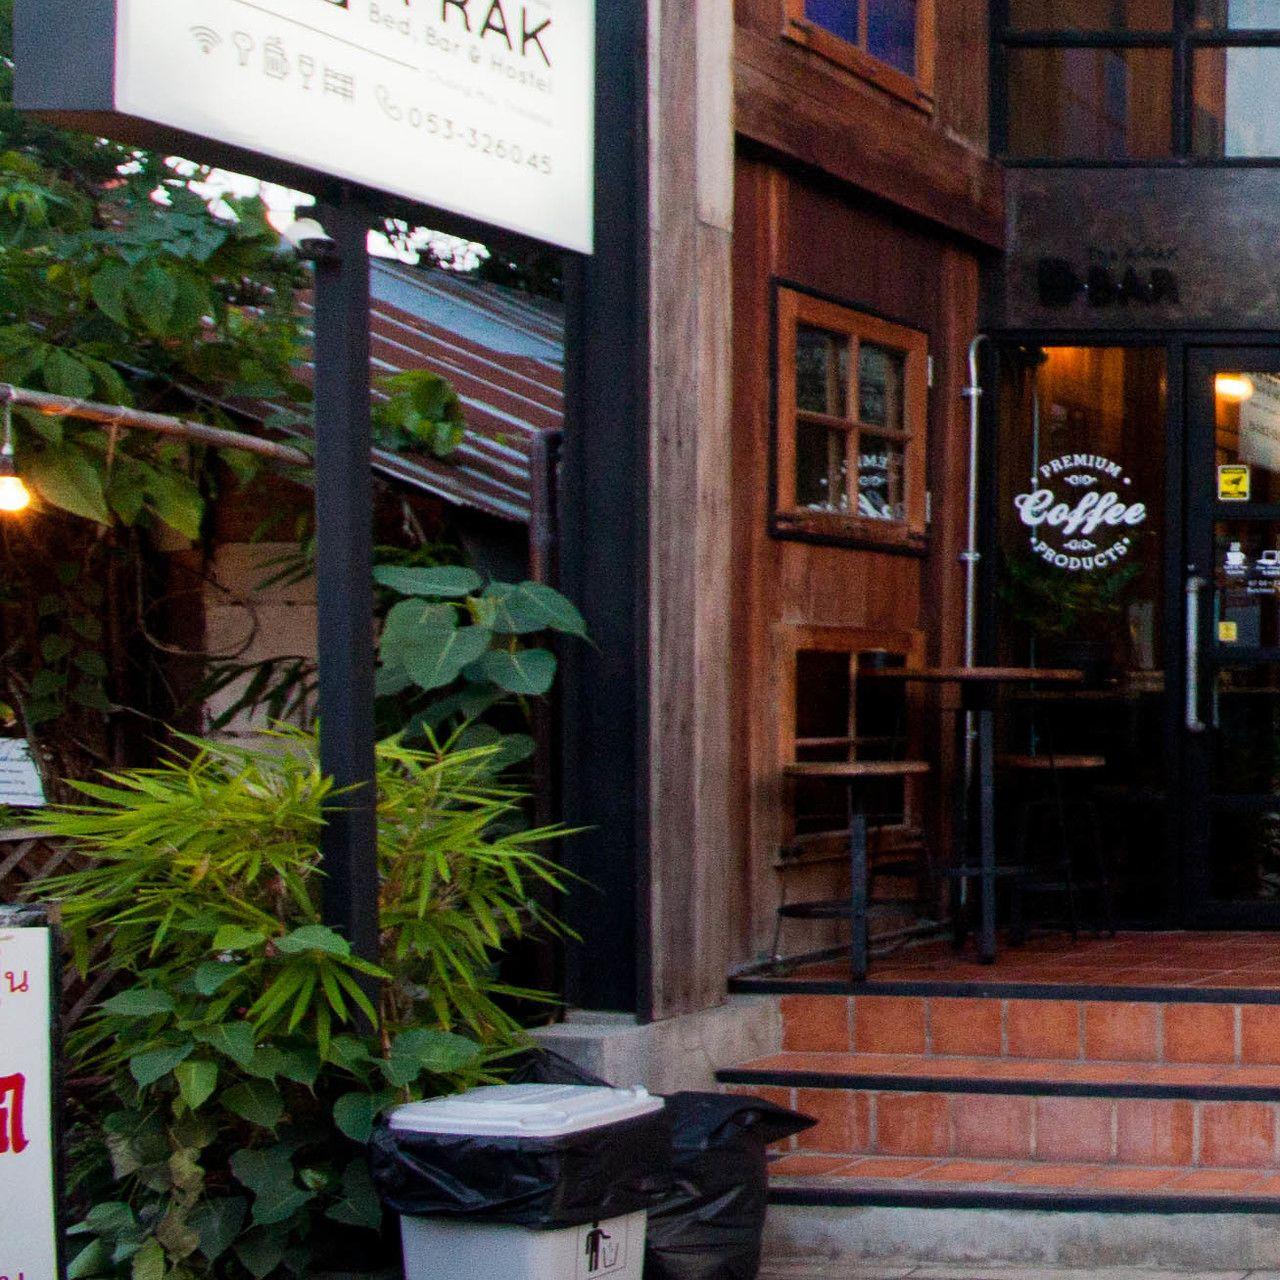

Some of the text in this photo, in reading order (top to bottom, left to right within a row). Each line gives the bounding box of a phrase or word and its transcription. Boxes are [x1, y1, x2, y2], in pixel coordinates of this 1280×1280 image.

[425, 24, 461, 54] Bar
[490, 54, 554, 95] Hostel
[407, 106, 552, 176] 053-326045
[1039, 453, 1123, 478] PREMIUM
[1014, 489, 1147, 536] Coffee
[1033, 540, 1128, 570] PRODUCTS
